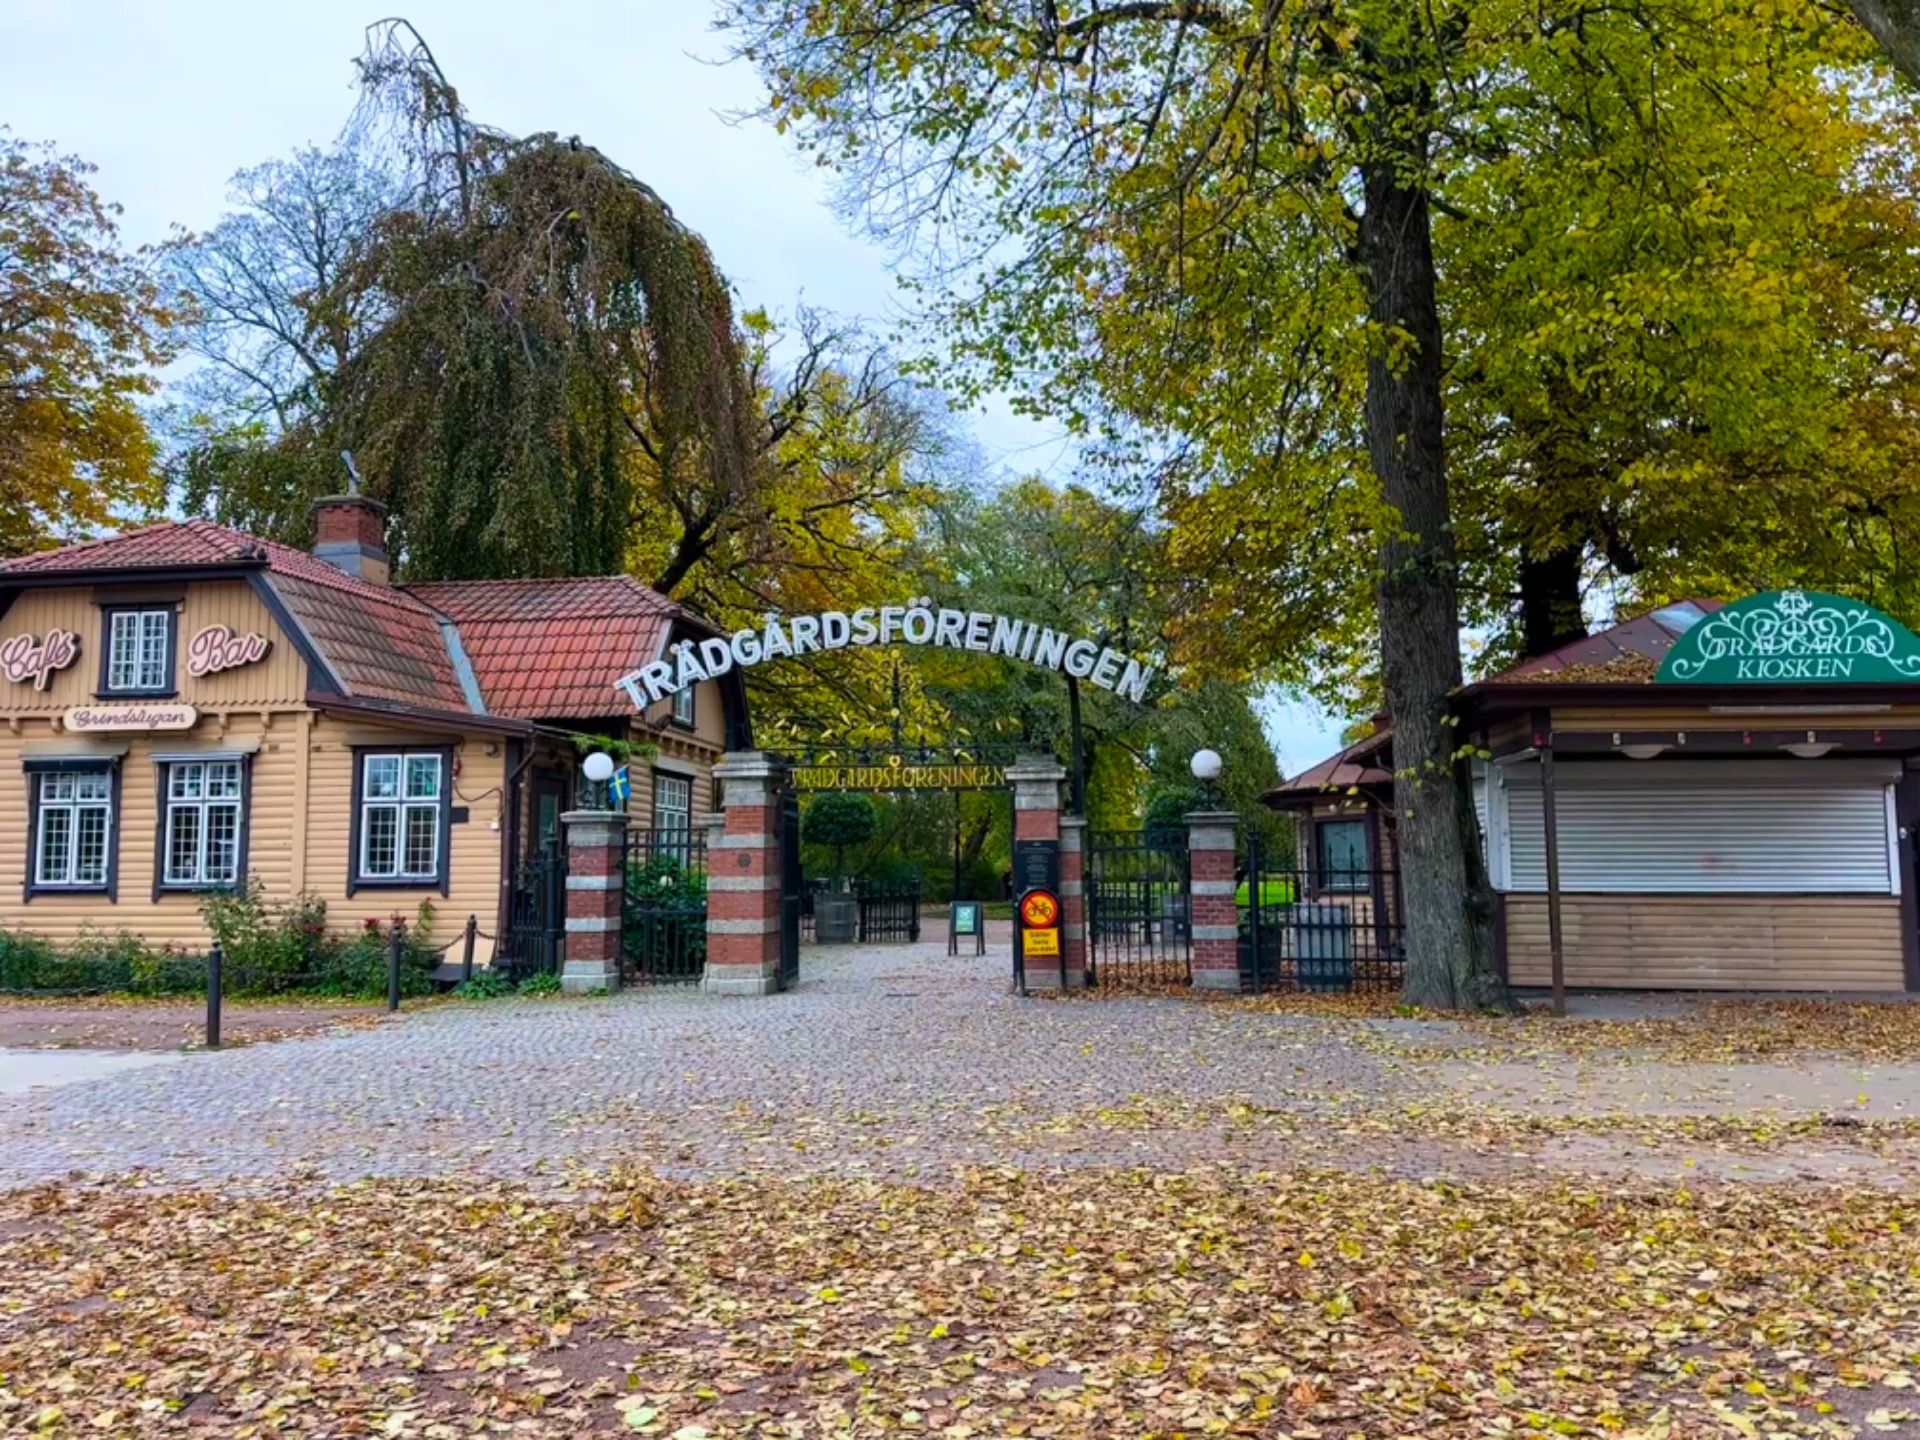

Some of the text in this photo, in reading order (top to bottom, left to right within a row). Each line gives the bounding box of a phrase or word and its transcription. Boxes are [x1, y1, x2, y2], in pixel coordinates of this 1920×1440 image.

[1, 629, 74, 690] Café
[189, 625, 268, 678] Bar
[614, 596, 1155, 712] TRÄDGÅRDSFÖRENINGEN
[1736, 658, 1855, 678] KIOSKEN
